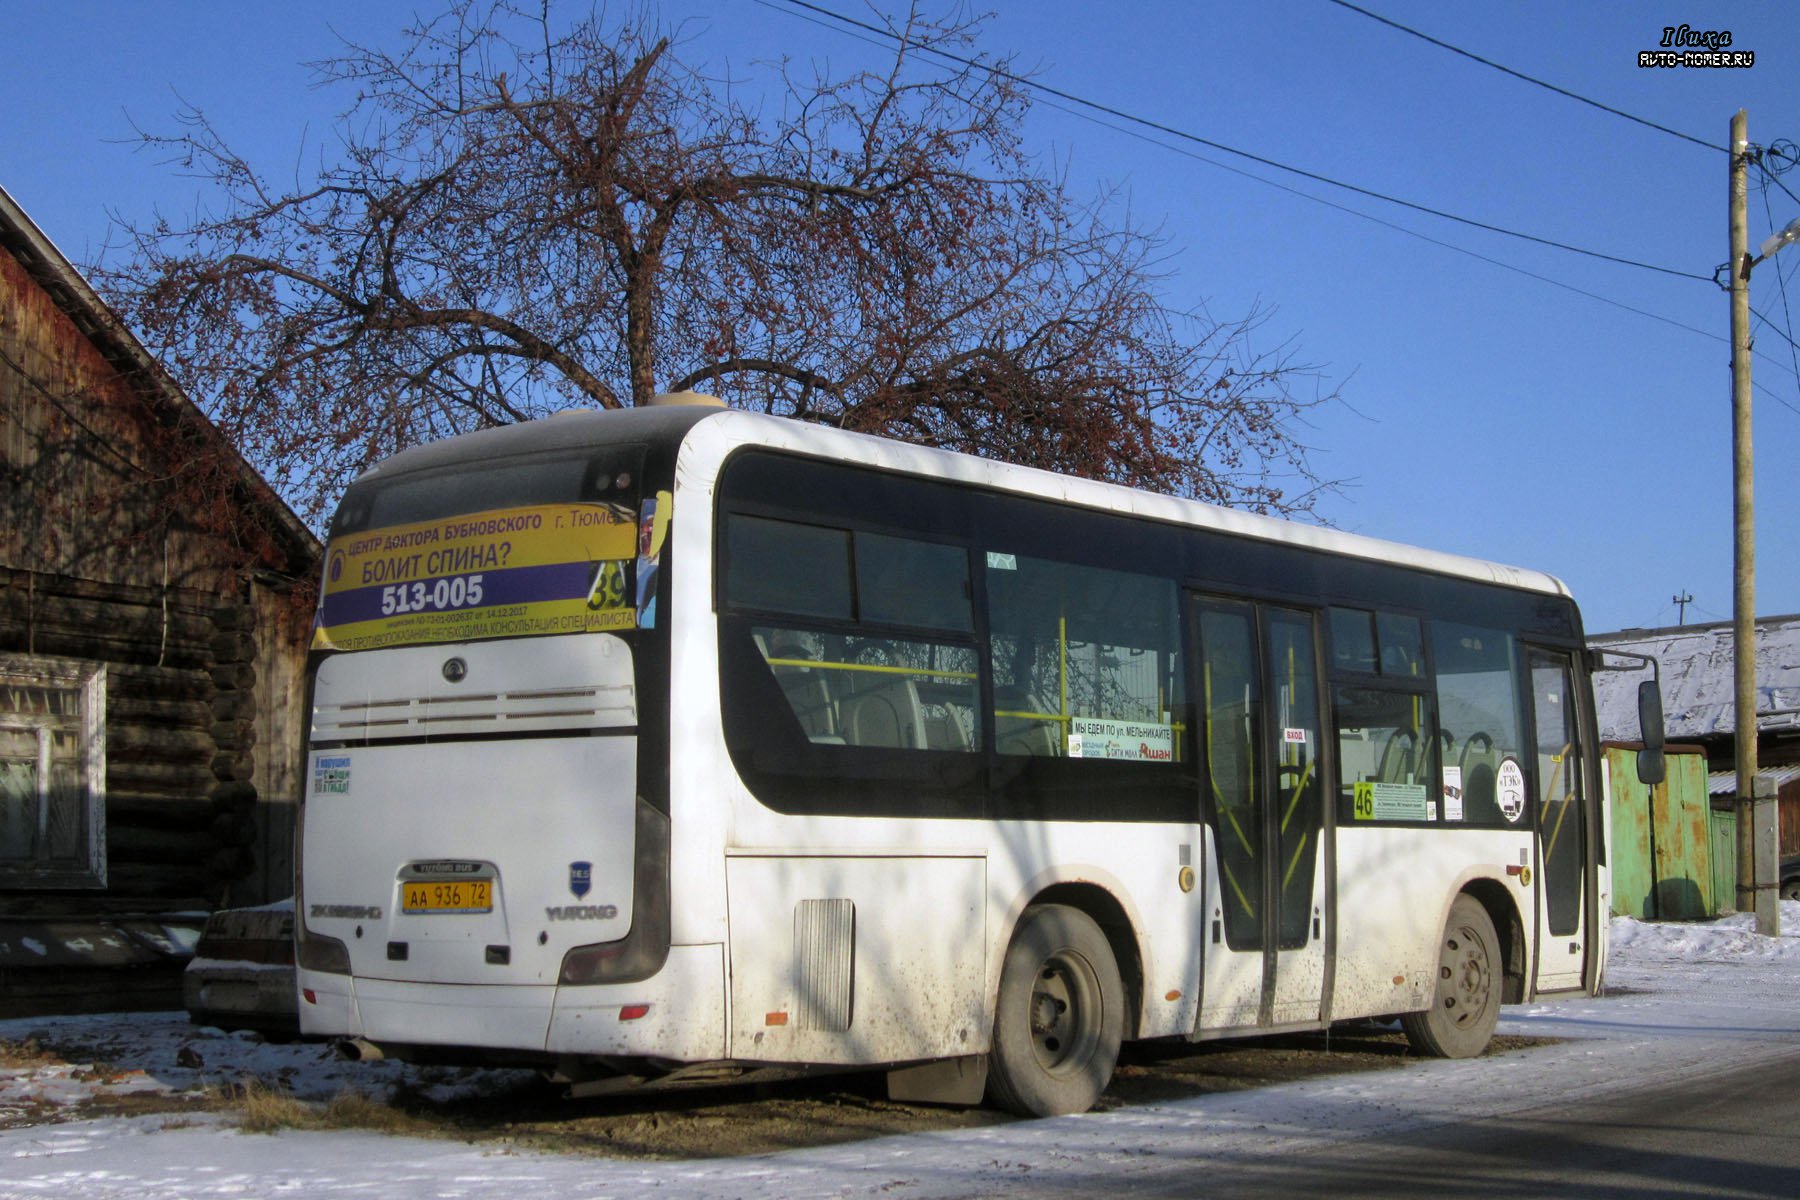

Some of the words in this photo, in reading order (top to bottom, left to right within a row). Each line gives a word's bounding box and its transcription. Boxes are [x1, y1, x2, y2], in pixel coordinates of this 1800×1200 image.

[348, 536, 383, 557] ЦЕНТР
[384, 527, 439, 552] ДОКТОРА
[444, 513, 542, 541] БУБНОВСКОГО
[555, 515, 564, 529] г.
[361, 553, 423, 584] БОЛИТ
[427, 541, 512, 575] СПИНА?
[381, 574, 484, 616] 513-005
[487, 606, 528, 618] 14.12.2017
[490, 616, 560, 635] КОНСУЛЬТАЦИЯ
[561, 611, 634, 629] СПЕЦИАЛИСТА
[1075, 722, 1086, 734] МЫ
[1088, 723, 1105, 736] ЕДЕМ
[1106, 725, 1115, 736] ПО
[1116, 728, 1125, 738] ул.
[1126, 726, 1171, 740] МЕЛЬНИКАЙТЕ
[1286, 731, 1303, 740] ВХОД
[1503, 764, 1516, 773] ООО
[1356, 788, 1373, 816] 46
[434, 884, 461, 906] 936
[471, 883, 486, 900] 72
[545, 905, 618, 921] YUTONG
